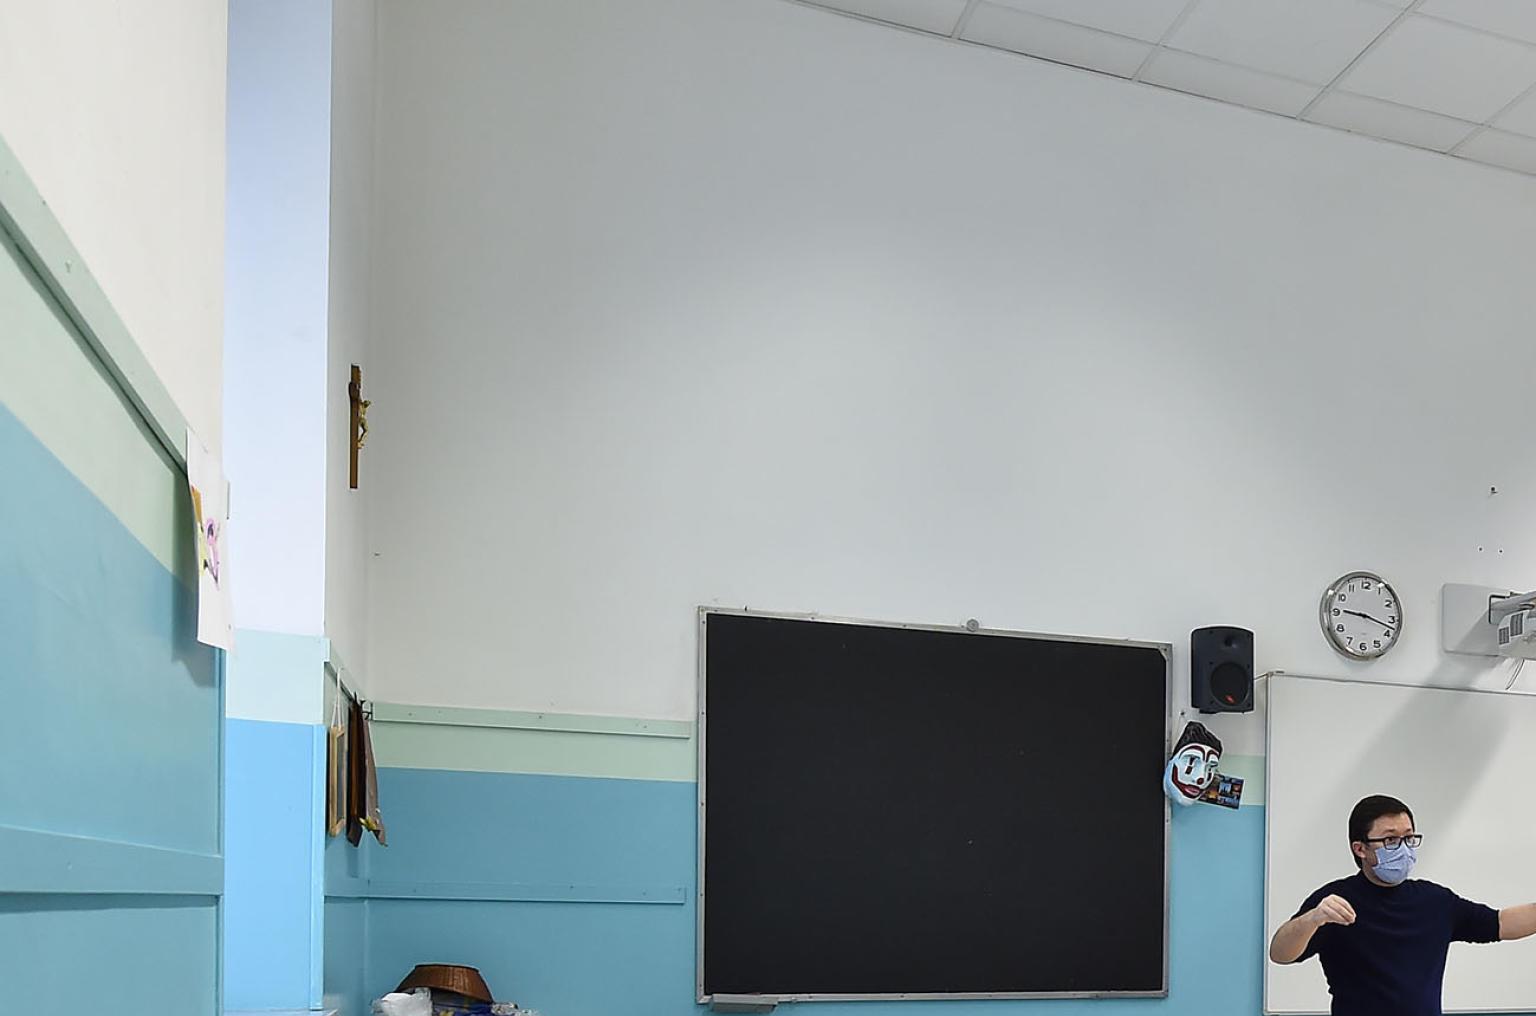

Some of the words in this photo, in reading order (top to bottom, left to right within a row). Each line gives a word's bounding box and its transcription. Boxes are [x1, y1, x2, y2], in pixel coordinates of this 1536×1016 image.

[1348, 584, 1355, 593] 11
[1361, 581, 1371, 590] 12
[1338, 593, 1346, 602] 10
[1385, 600, 1393, 608] 2
[1332, 608, 1340, 617] 9
[1388, 615, 1396, 624] 3
[1336, 624, 1345, 632] 8
[1383, 629, 1391, 637] 4
[1346, 636, 1353, 645] 7
[1373, 639, 1382, 648] 5
[1359, 642, 1367, 651] 6
